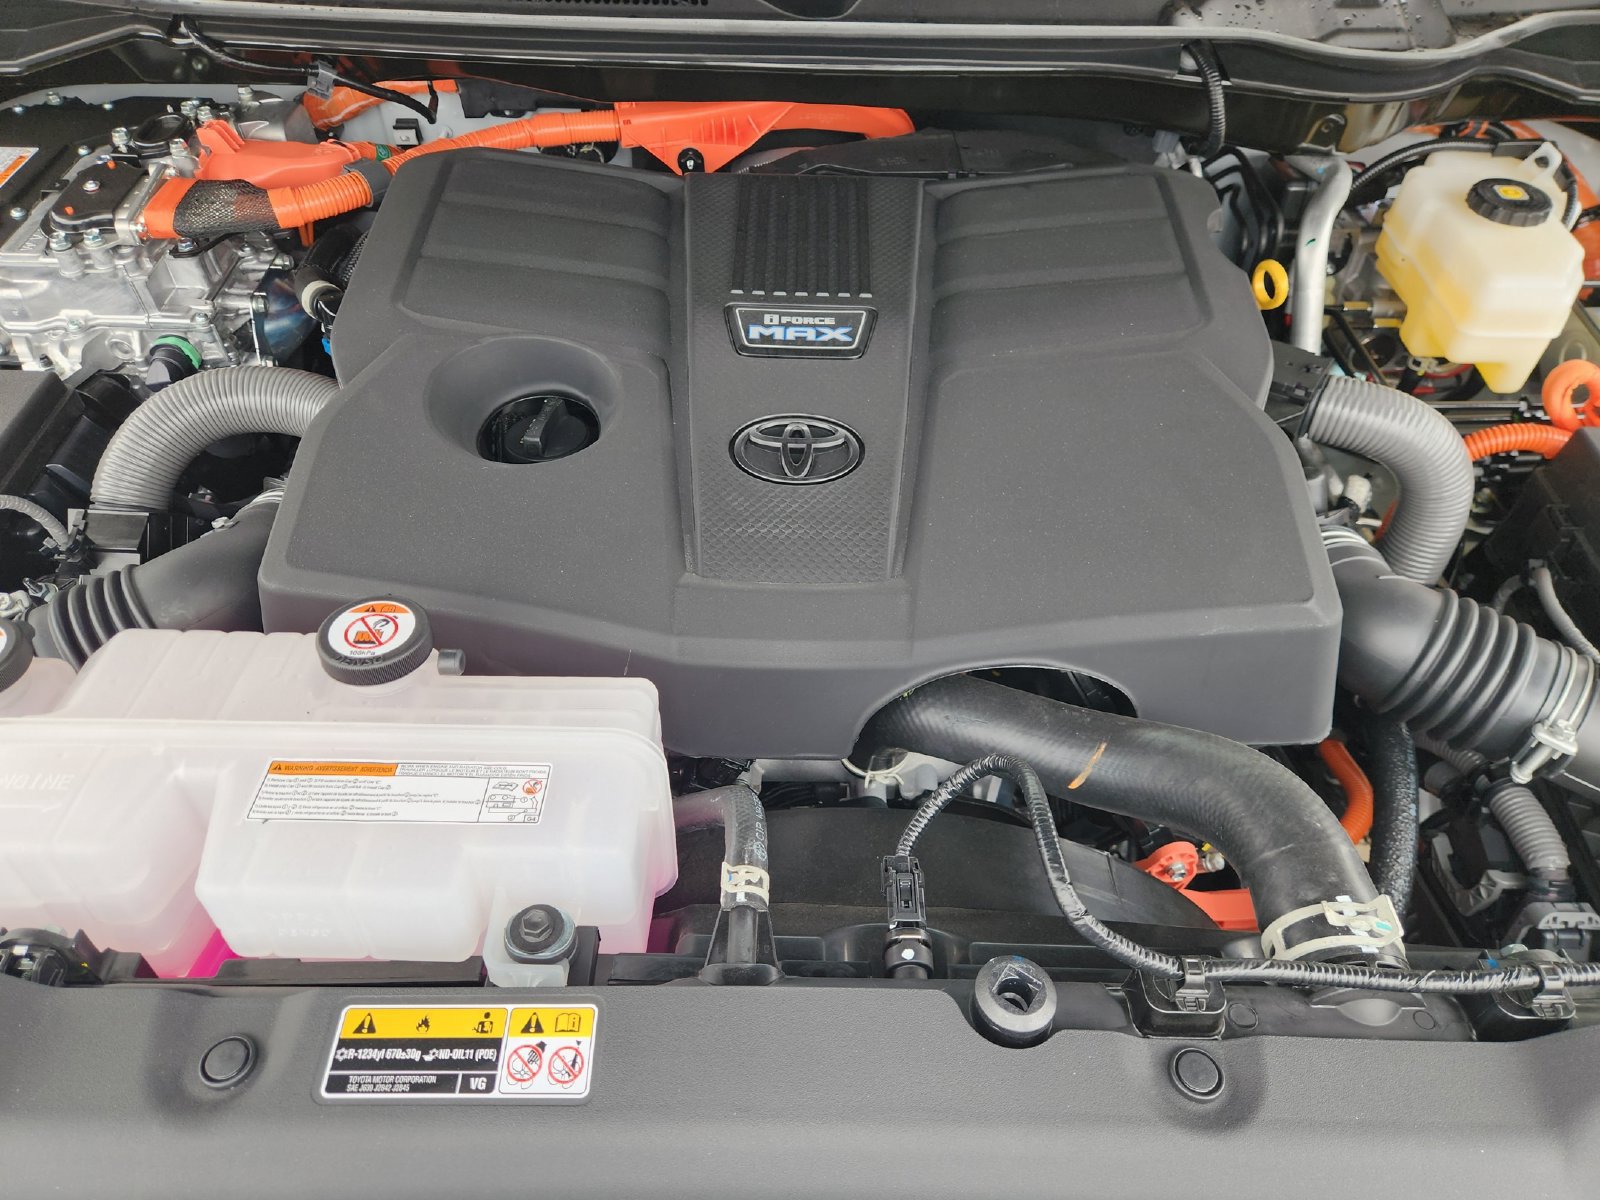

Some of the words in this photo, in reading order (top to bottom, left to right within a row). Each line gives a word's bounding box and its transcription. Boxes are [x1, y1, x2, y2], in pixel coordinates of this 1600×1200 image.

[749, 324, 853, 342] MAX
[475, 1048, 497, 1062] (POE)
[348, 1075, 372, 1083] TOYOTA
[372, 1076, 395, 1084] MOTOR
[395, 1076, 437, 1084] CORPORATION
[469, 1077, 488, 1091] VG
[346, 1084, 359, 1092] SAE
